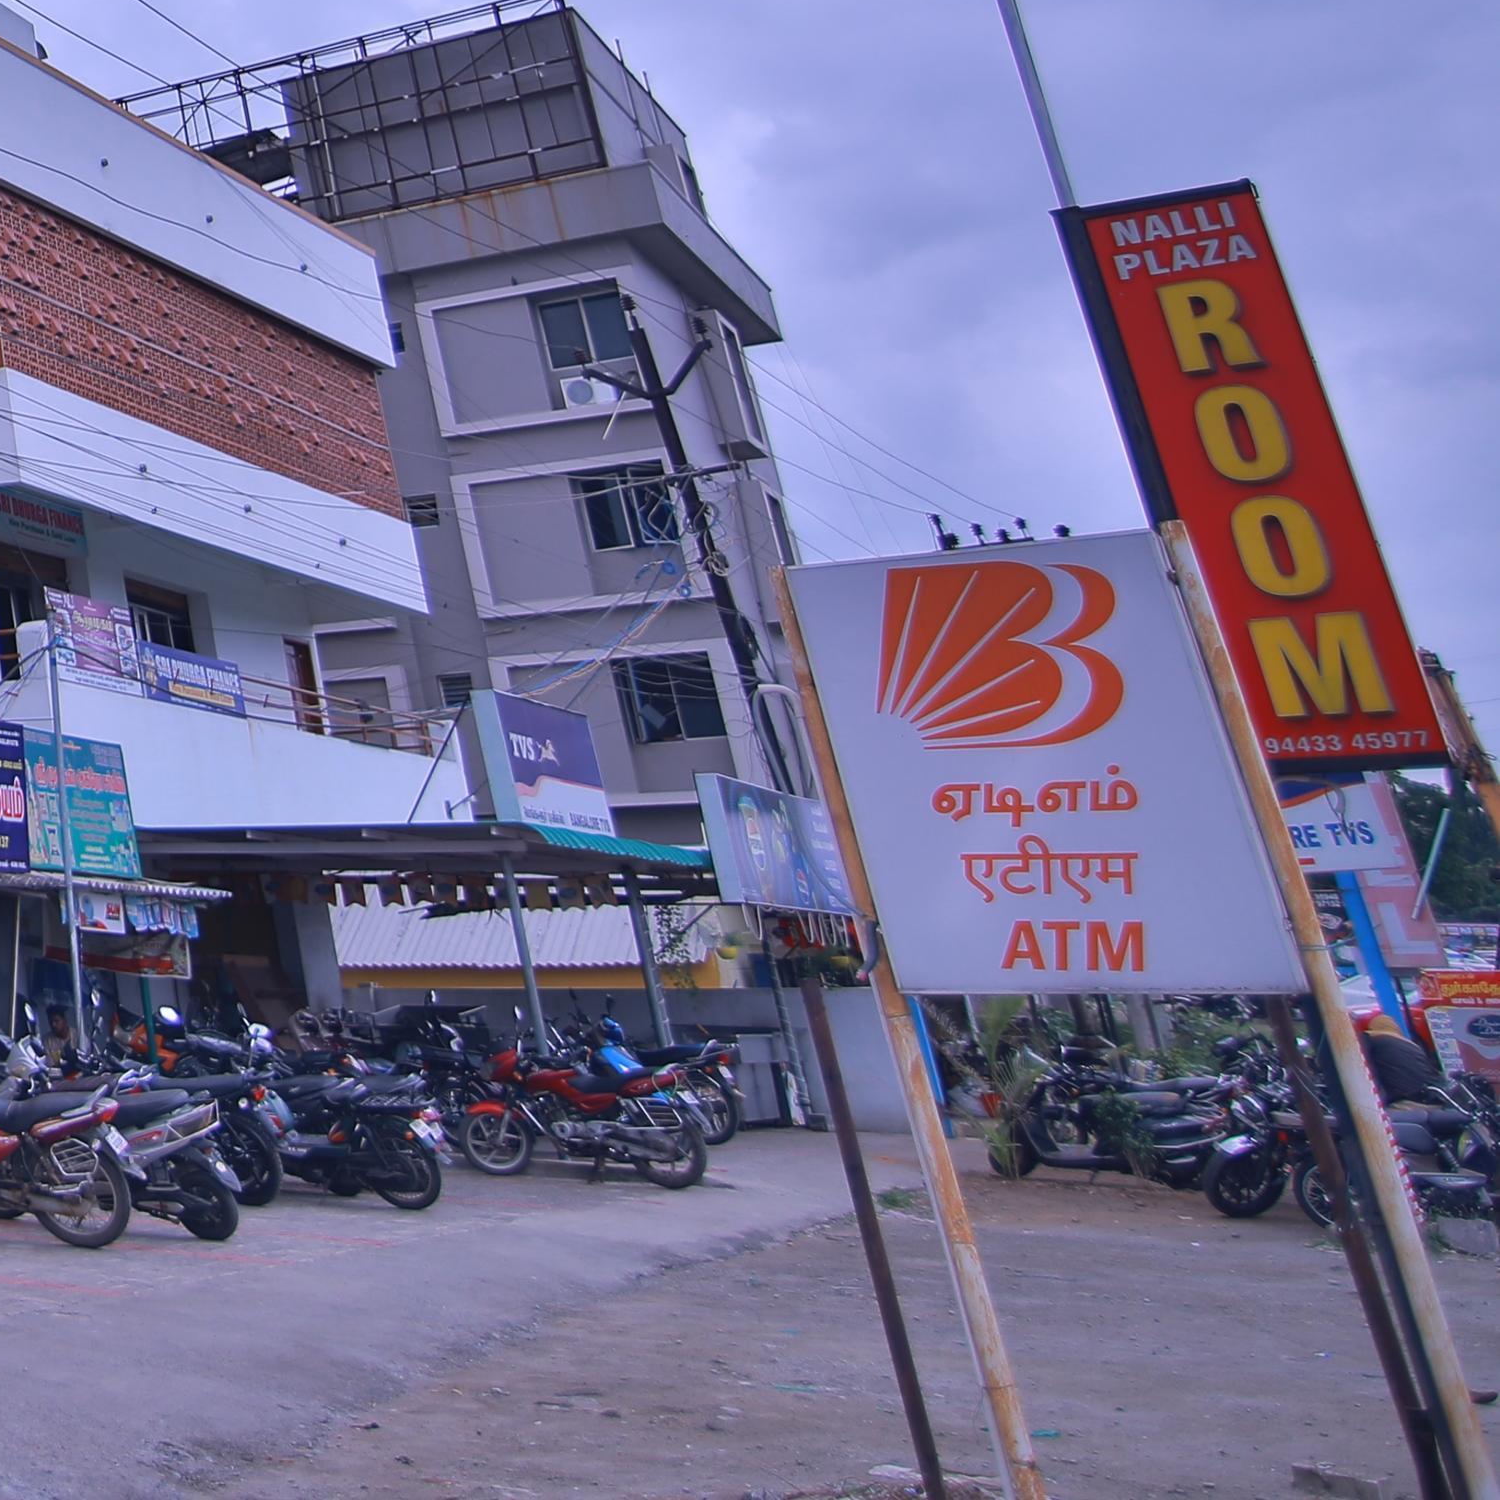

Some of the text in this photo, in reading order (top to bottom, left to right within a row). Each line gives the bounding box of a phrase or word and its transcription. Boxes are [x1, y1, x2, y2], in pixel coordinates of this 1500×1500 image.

[1110, 202, 1235, 247] NALLI
[1113, 234, 1257, 280] PLAZA
[1156, 278, 1396, 721] ROOM
[154, 654, 171, 674] SRI
[206, 667, 240, 688] FINANCE
[509, 732, 535, 761] TVS
[1265, 729, 1429, 757] 94433 45977
[931, 763, 1139, 828] ஏடிஎம்
[1291, 820, 1375, 848] RE TVS
[960, 835, 1140, 904] एटीएम
[1000, 921, 1147, 973] ATM
